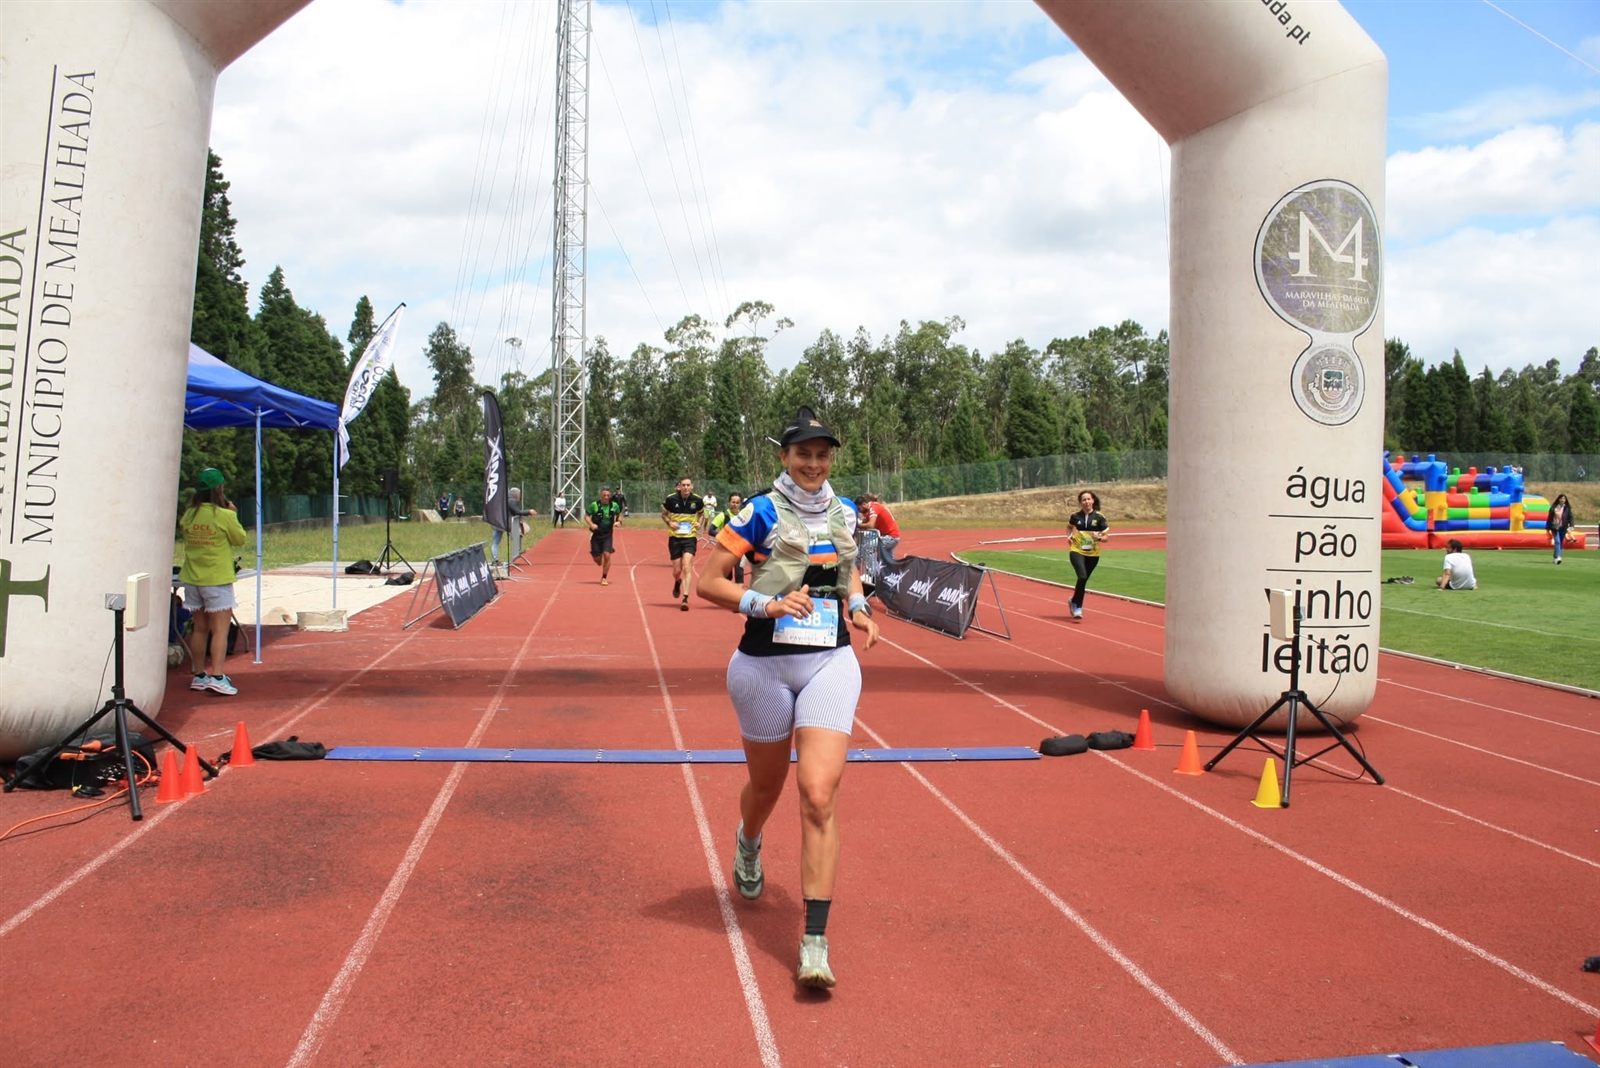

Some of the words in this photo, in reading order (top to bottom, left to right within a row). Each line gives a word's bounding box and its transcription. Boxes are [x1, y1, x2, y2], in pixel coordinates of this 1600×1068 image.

[46, 69, 97, 272] MEALHADA
[41, 280, 76, 330] DE
[1317, 301, 1360, 312] MEALHADA
[22, 336, 70, 546] MUNICÍPIO
[1286, 466, 1365, 508] água
[1295, 525, 1357, 564] pão
[908, 576, 938, 604] AMIX
[938, 584, 973, 614] AMIX
[1264, 579, 1372, 620] inho
[1262, 633, 1369, 675] leitão
